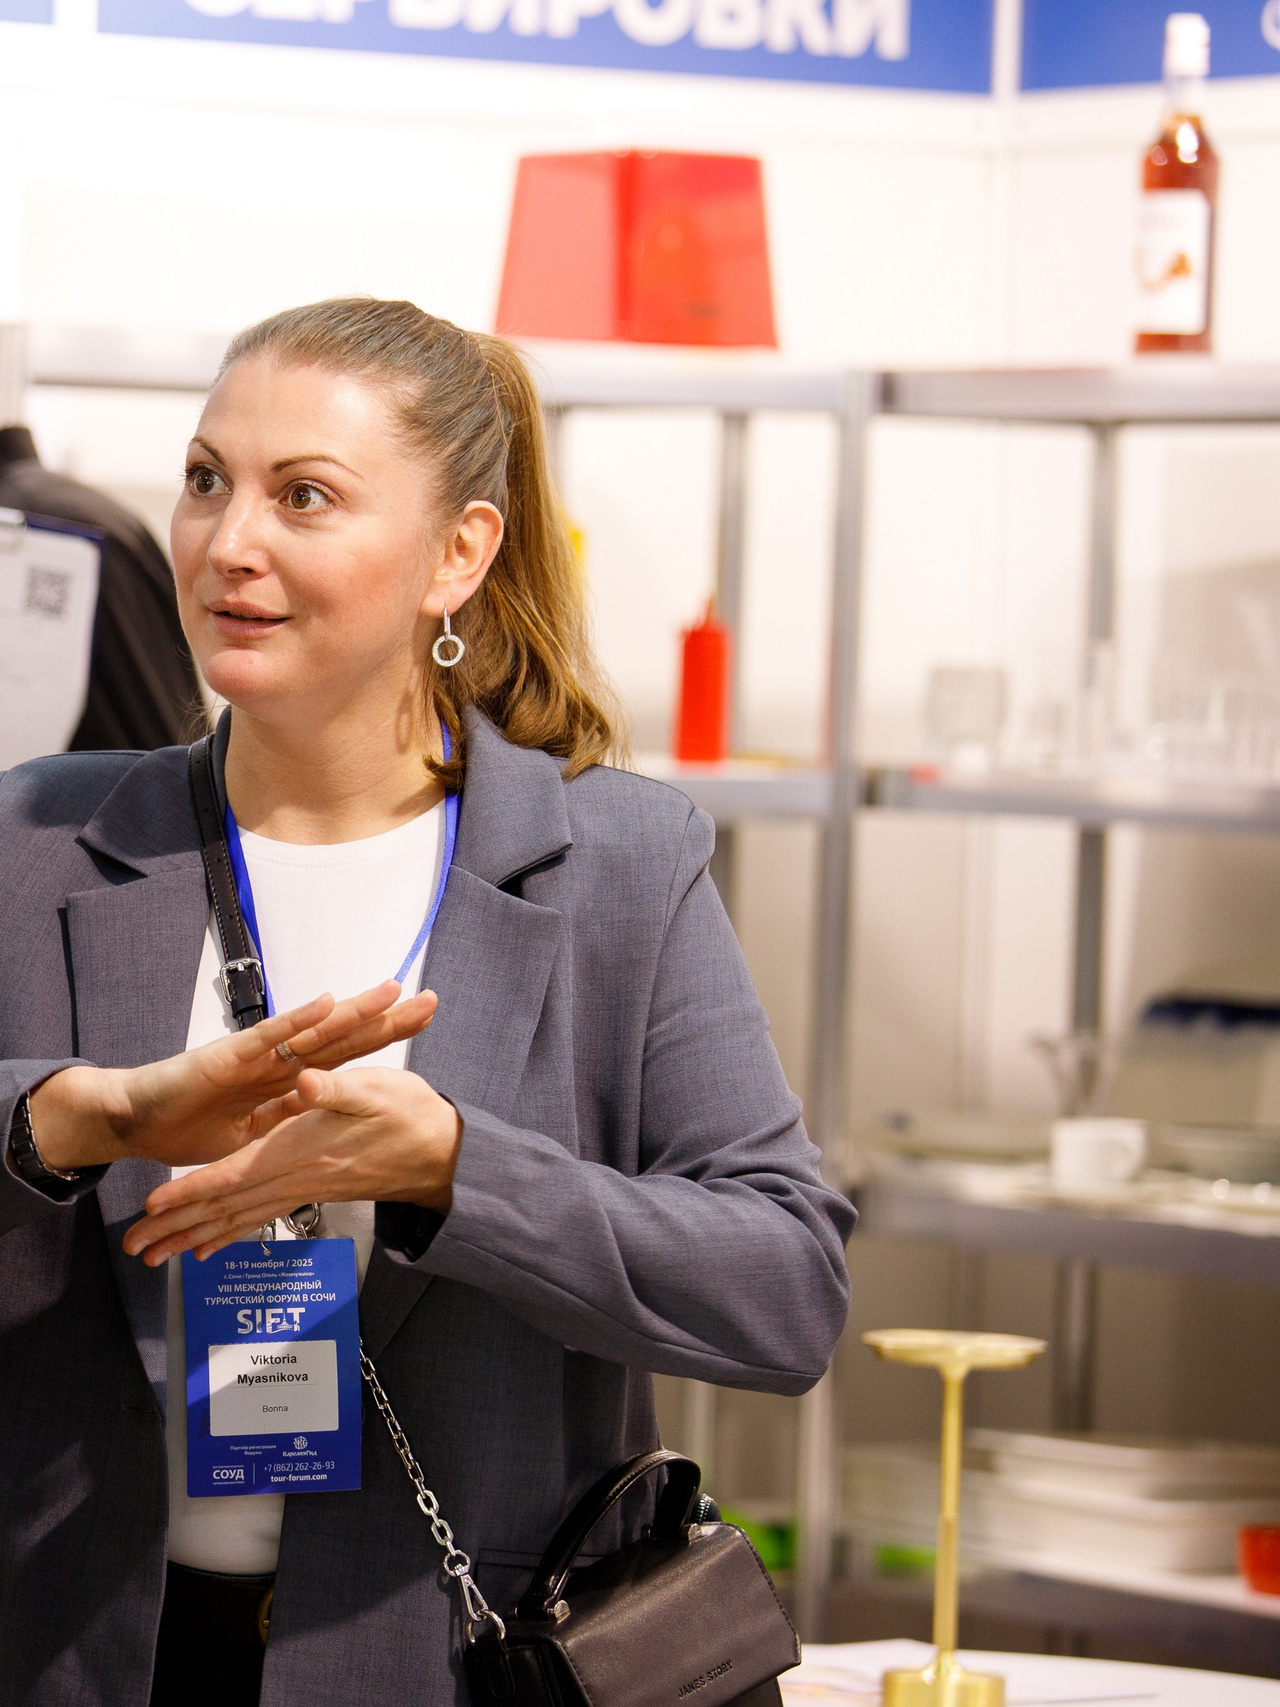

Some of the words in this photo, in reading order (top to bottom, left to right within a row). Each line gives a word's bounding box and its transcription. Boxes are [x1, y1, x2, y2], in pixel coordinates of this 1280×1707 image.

[184, 0, 910, 61] ИРОВКИ
[225, 1261, 249, 1269] 18-19
[251, 1260, 284, 1270] ноября
[291, 1259, 313, 1267] 2025
[218, 1284, 232, 1292] VIII
[234, 1280, 322, 1292] МЕЖДУНАРОДНЫЙ
[205, 1295, 264, 1305] ТУРИСТСКИЙ
[266, 1294, 301, 1303] ФОРУМ
[302, 1294, 309, 1302] В
[310, 1292, 336, 1302] СОЧИ
[250, 1353, 297, 1365] Viktoria
[237, 1372, 309, 1386] Myasnikova
[262, 1404, 288, 1413] Bonna
[264, 1464, 272, 1472] +7
[273, 1463, 293, 1473] (862)
[294, 1461, 335, 1471] 262-26-93
[212, 1469, 245, 1480] СОУД
[270, 1473, 327, 1482] tour-forum.com
[678, 1676, 707, 1699] JANES
[706, 1659, 734, 1683] STORY
